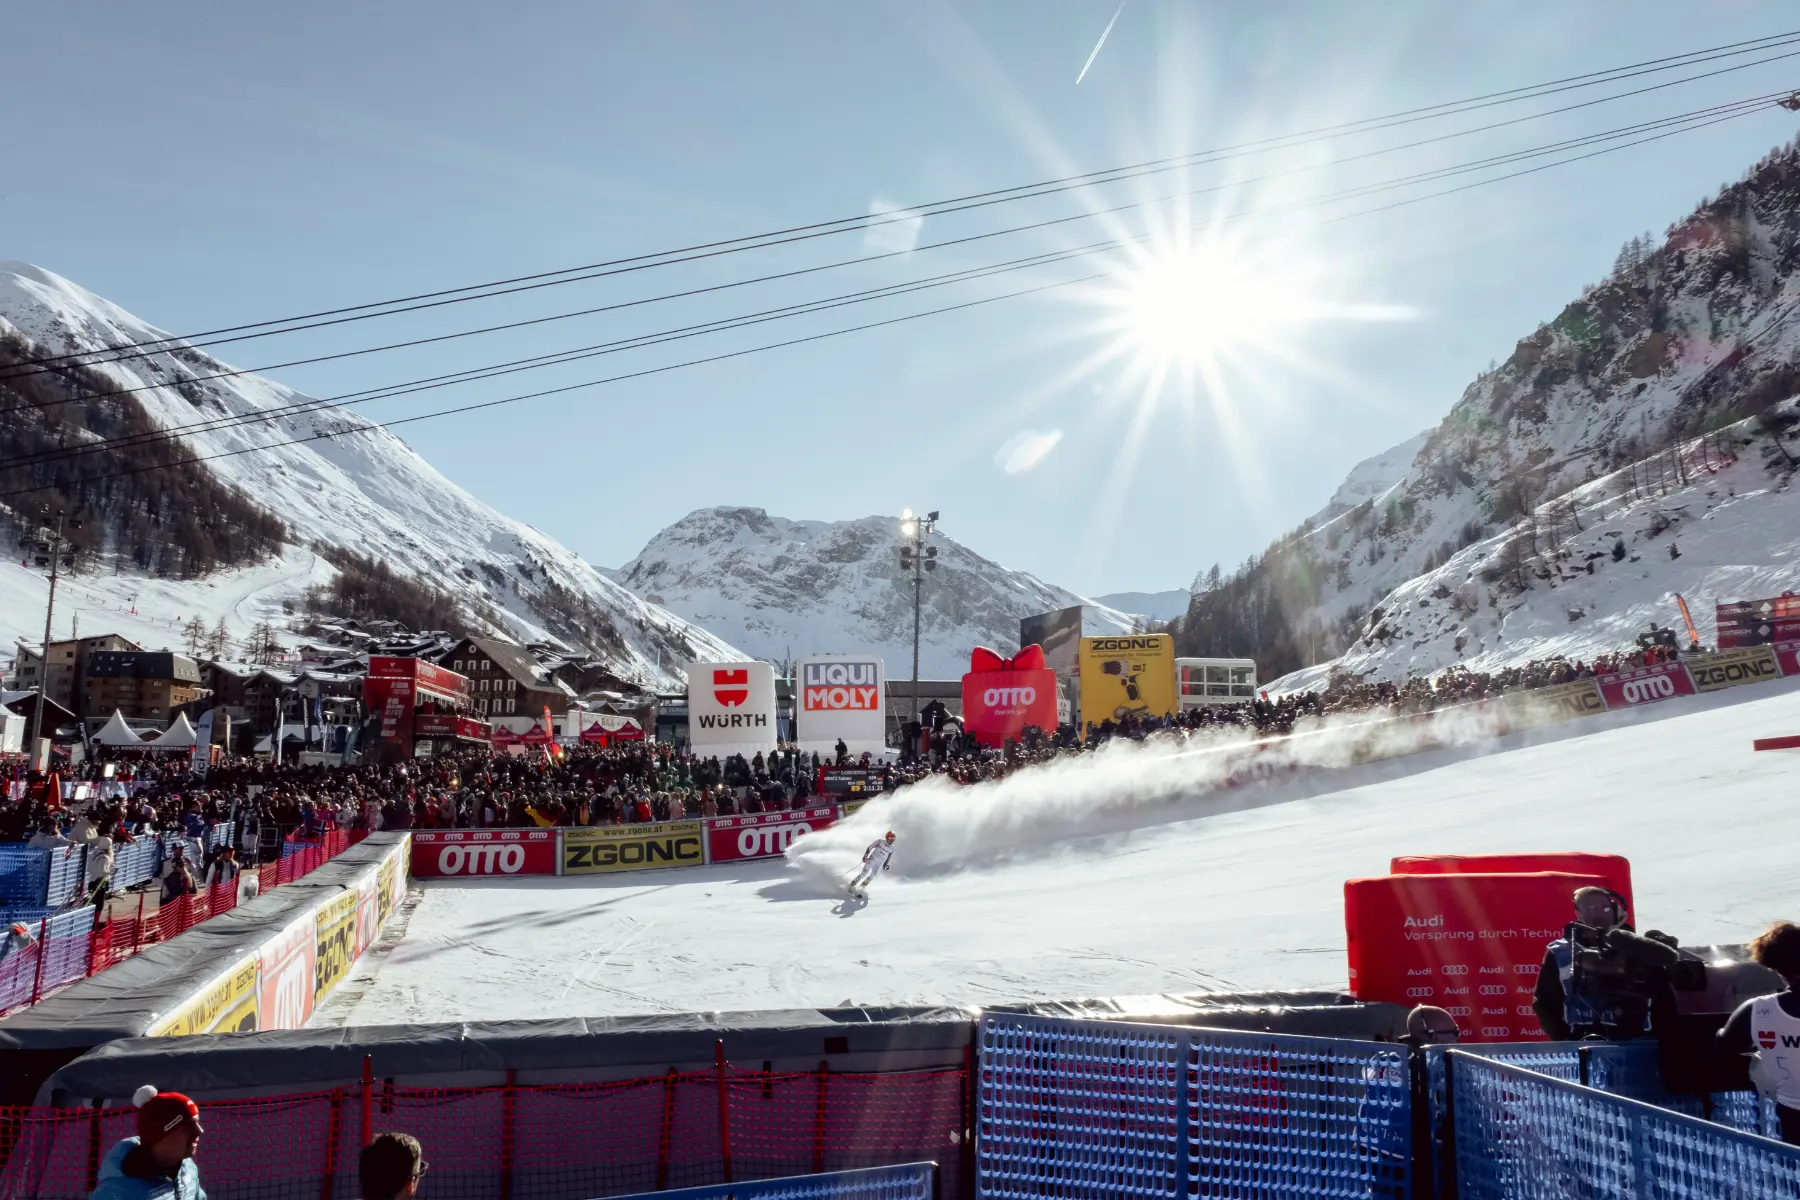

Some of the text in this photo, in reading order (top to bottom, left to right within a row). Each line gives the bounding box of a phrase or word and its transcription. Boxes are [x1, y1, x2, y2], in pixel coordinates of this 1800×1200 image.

[1092, 638, 1159, 650] ZGONC
[807, 664, 874, 686] LIQUI
[1693, 658, 1776, 686] ZGONC
[1623, 674, 1674, 704] OTTO
[808, 688, 876, 708] MOLY
[984, 687, 1036, 707] OTTO
[715, 808, 831, 828] OTTO OTTO OTTO OTTO OTTO
[415, 833, 436, 841] OTTO
[473, 832, 492, 840] OTTO
[603, 826, 663, 837] www.zgonc.at
[669, 823, 697, 831] ZGONC
[438, 843, 525, 875] OTTO
[566, 838, 700, 869] ZGONC
[1404, 915, 1444, 928] Audi
[1404, 931, 1475, 941] Vorsprung
[1479, 928, 1517, 939] durch
[1407, 966, 1504, 976] Audi Audi
[1444, 986, 1469, 994] Audi
[1482, 1006, 1507, 1015] Audi
[1781, 1035, 1800, 1048] W
